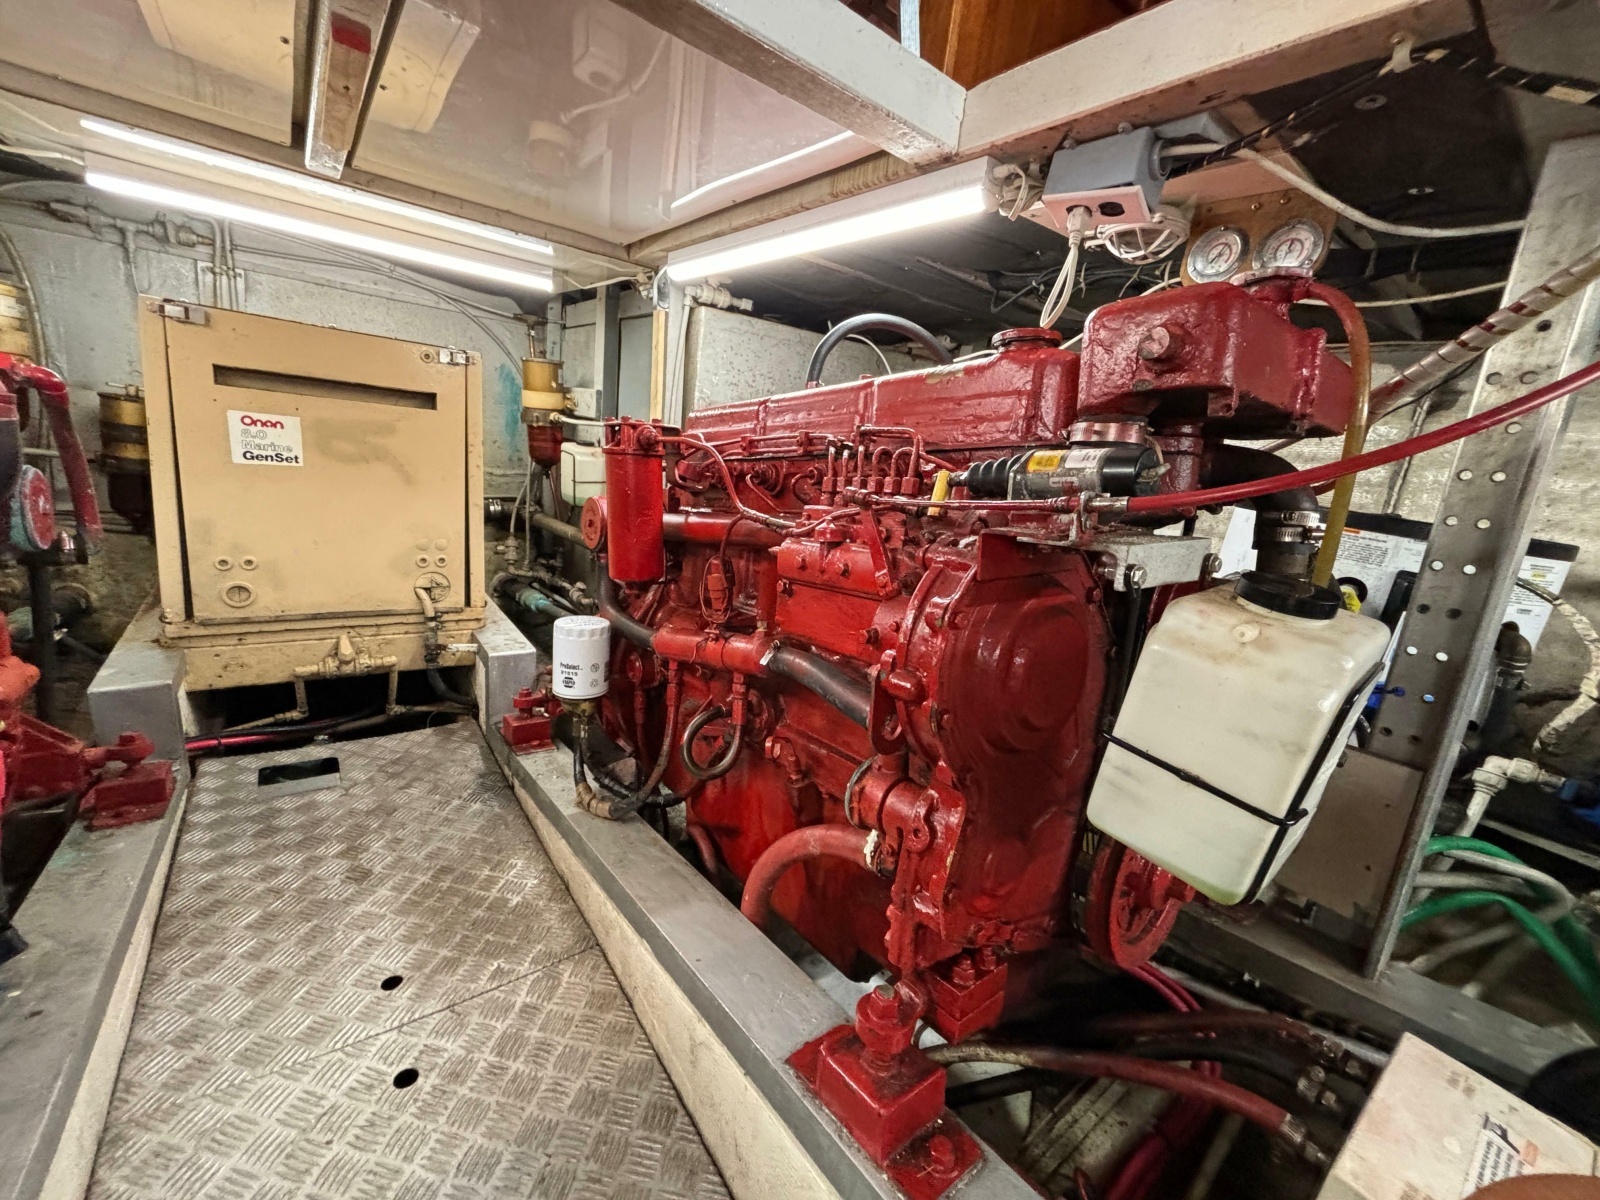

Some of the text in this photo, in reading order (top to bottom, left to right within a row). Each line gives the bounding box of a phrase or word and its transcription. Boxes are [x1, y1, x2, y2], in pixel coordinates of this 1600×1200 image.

[240, 415, 284, 429] Onan
[240, 428, 267, 440] 8.0
[241, 440, 293, 453] Marine
[242, 450, 300, 464] GenSet
